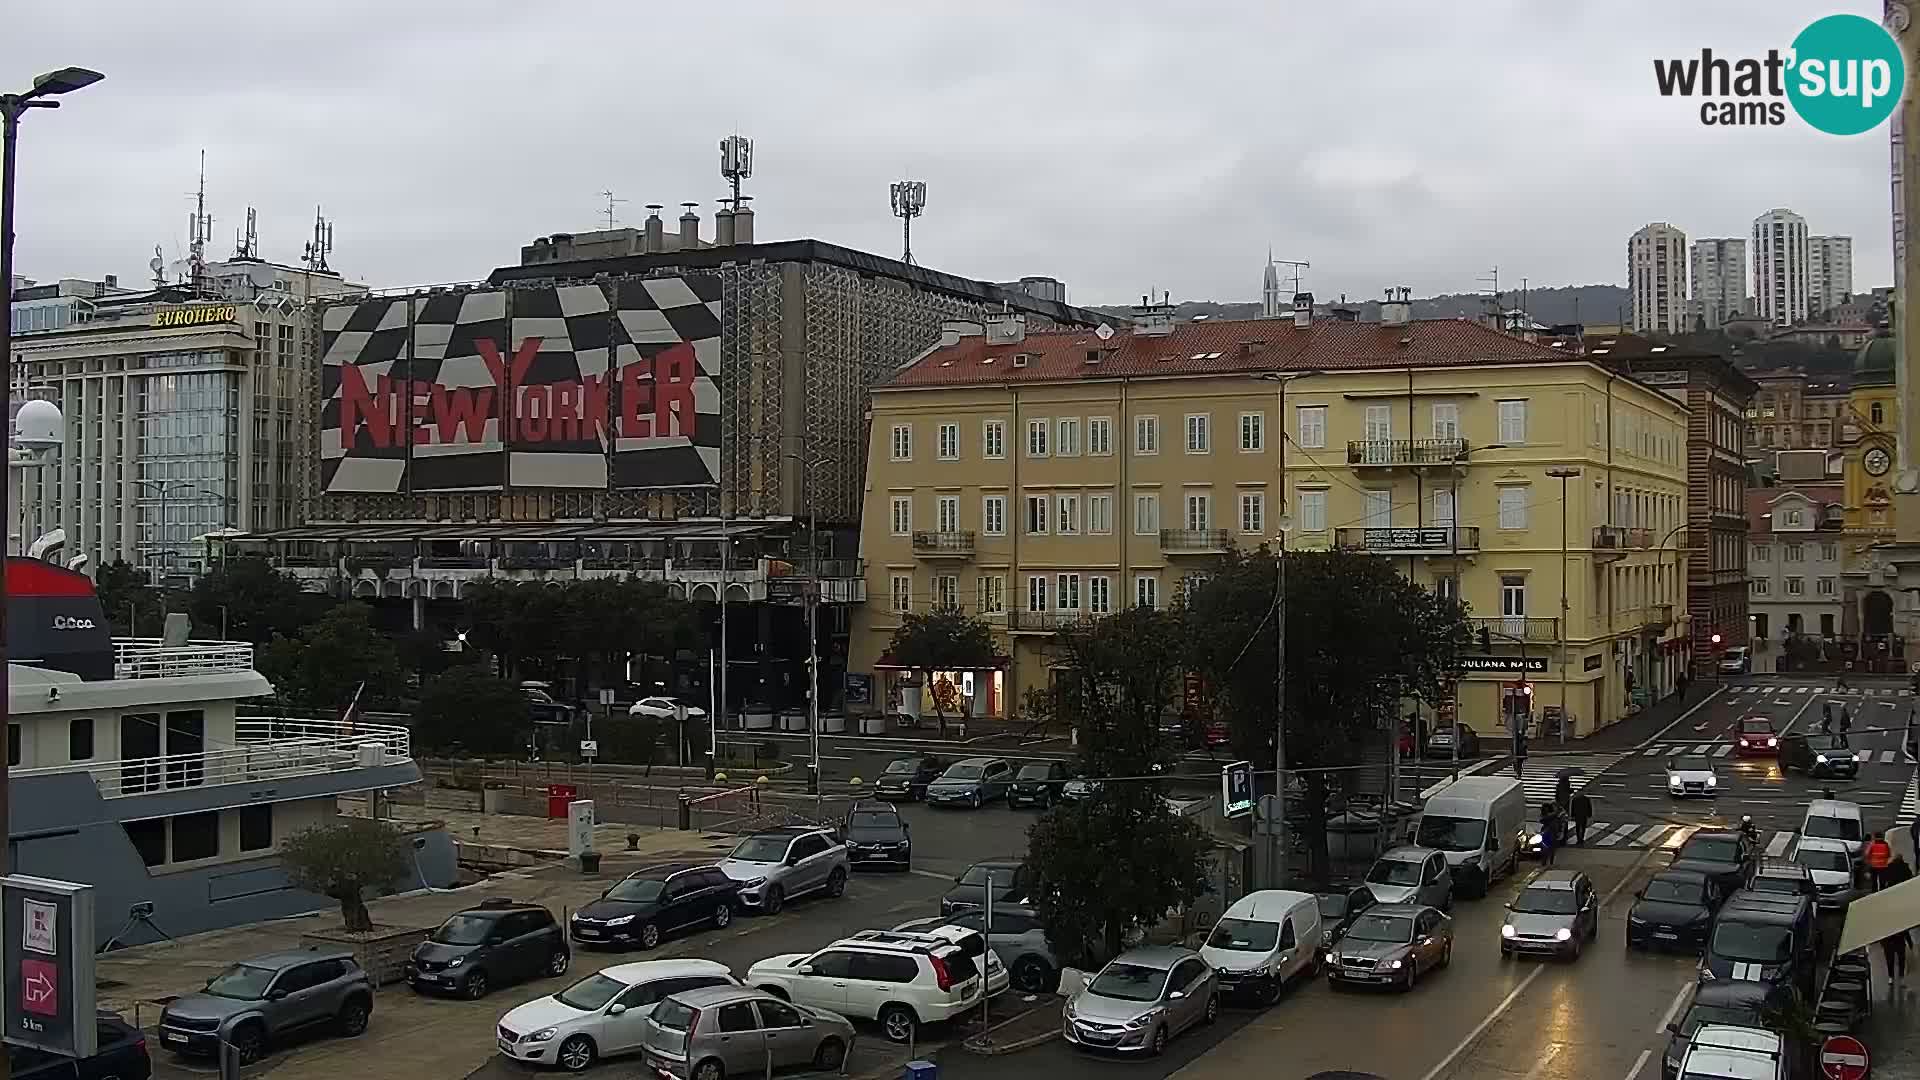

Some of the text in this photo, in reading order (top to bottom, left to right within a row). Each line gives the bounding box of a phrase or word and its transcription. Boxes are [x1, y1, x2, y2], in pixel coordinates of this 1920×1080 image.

[1461, 660, 1543, 669] JULIANA NAILS
[1233, 769, 1245, 793] P
[22, 1017, 43, 1032] 5 km
